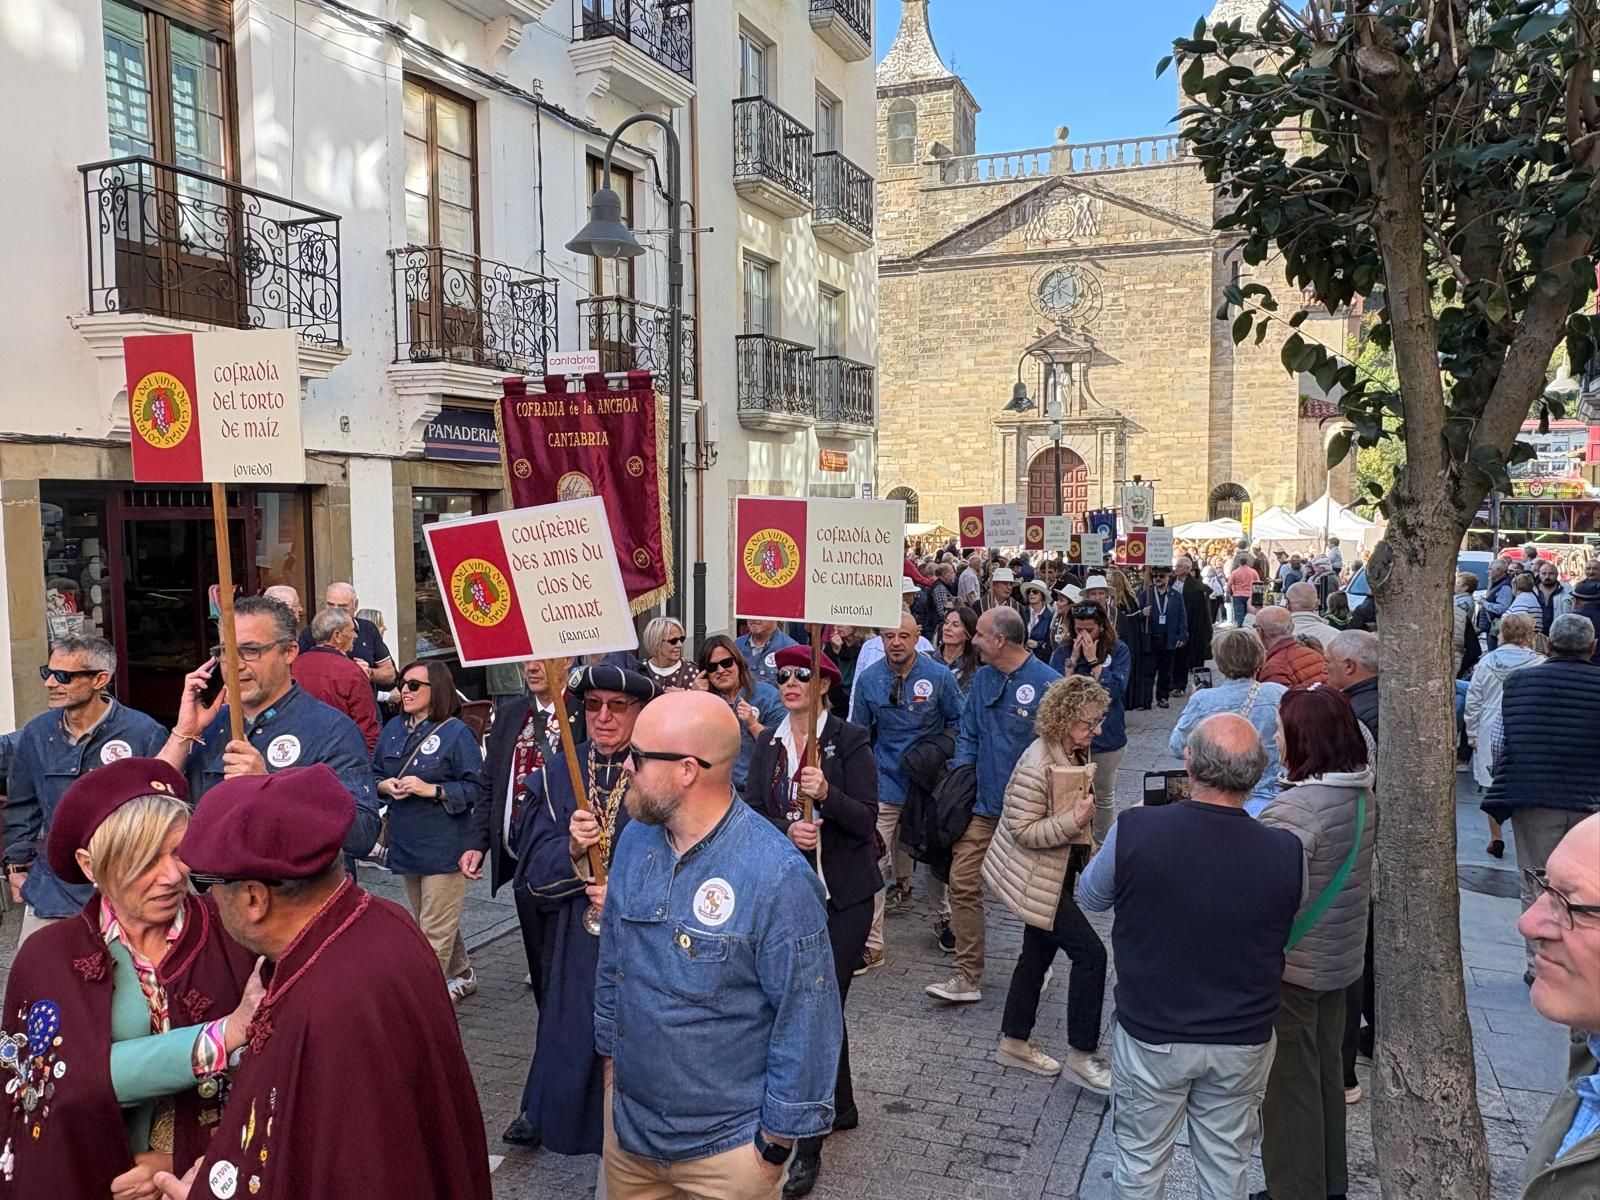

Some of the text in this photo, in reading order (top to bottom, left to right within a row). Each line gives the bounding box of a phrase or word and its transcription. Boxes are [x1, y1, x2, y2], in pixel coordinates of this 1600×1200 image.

[549, 354, 596, 365] cantabria
[516, 397, 639, 417] COFRADIA de la ANCHOA
[548, 431, 609, 447] CANTABRIA
[220, 1177, 234, 1194] PELO
